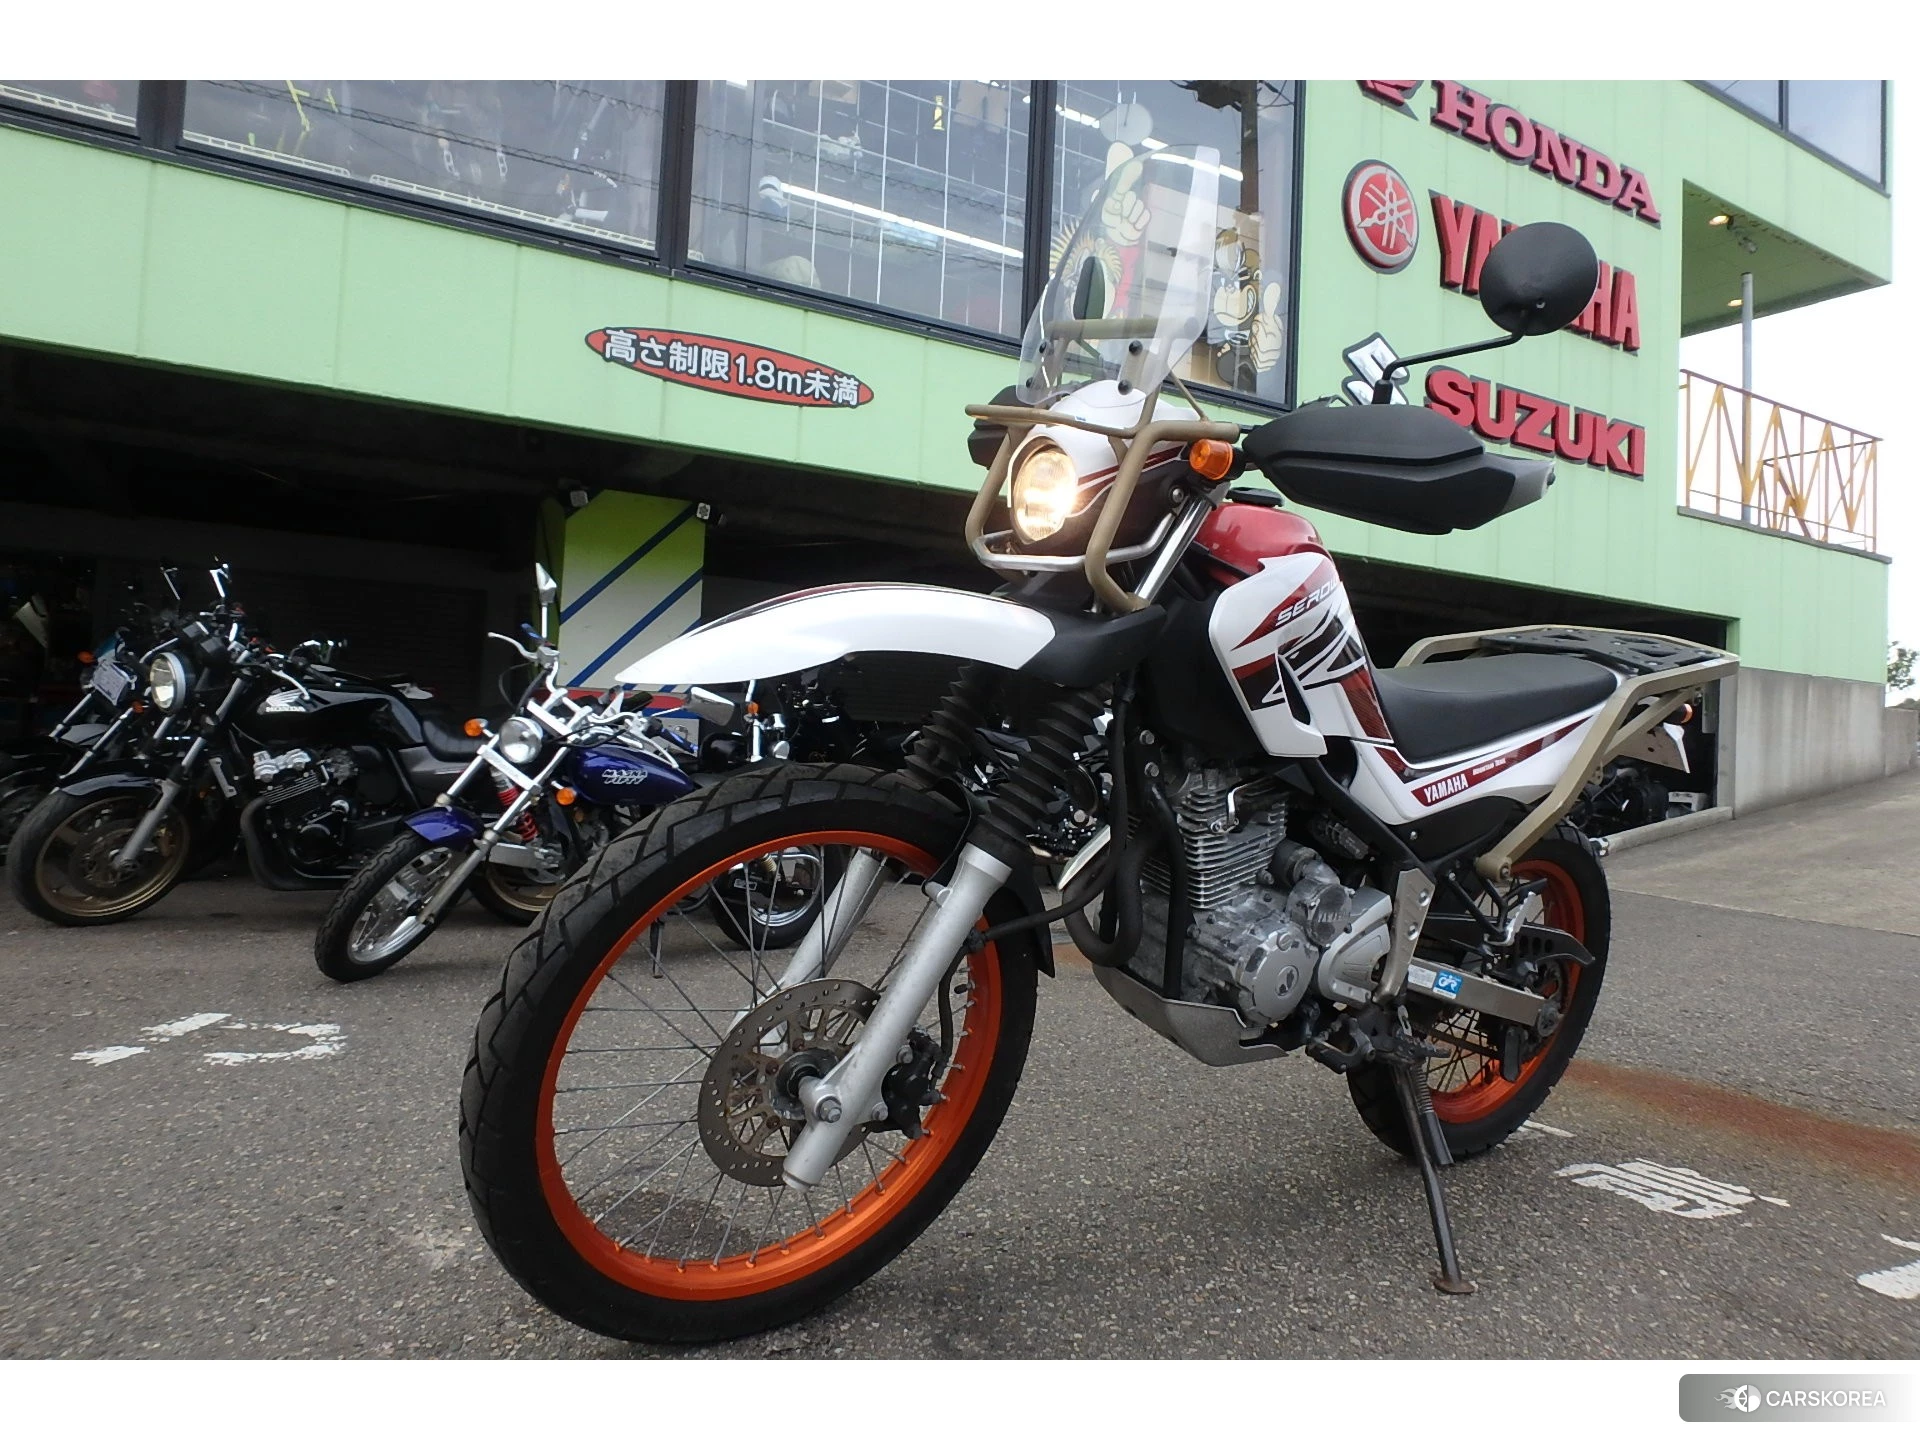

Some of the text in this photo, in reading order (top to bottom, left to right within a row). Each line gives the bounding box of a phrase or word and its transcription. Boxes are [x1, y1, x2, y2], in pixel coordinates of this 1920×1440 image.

[1431, 80, 1661, 227] HONDA
[1430, 190, 1640, 354] YAHA
[604, 329, 861, 406] 高さ制限1.8m未満
[1425, 367, 1645, 479] SUZUKI
[1423, 774, 1469, 803] YAMAHA
